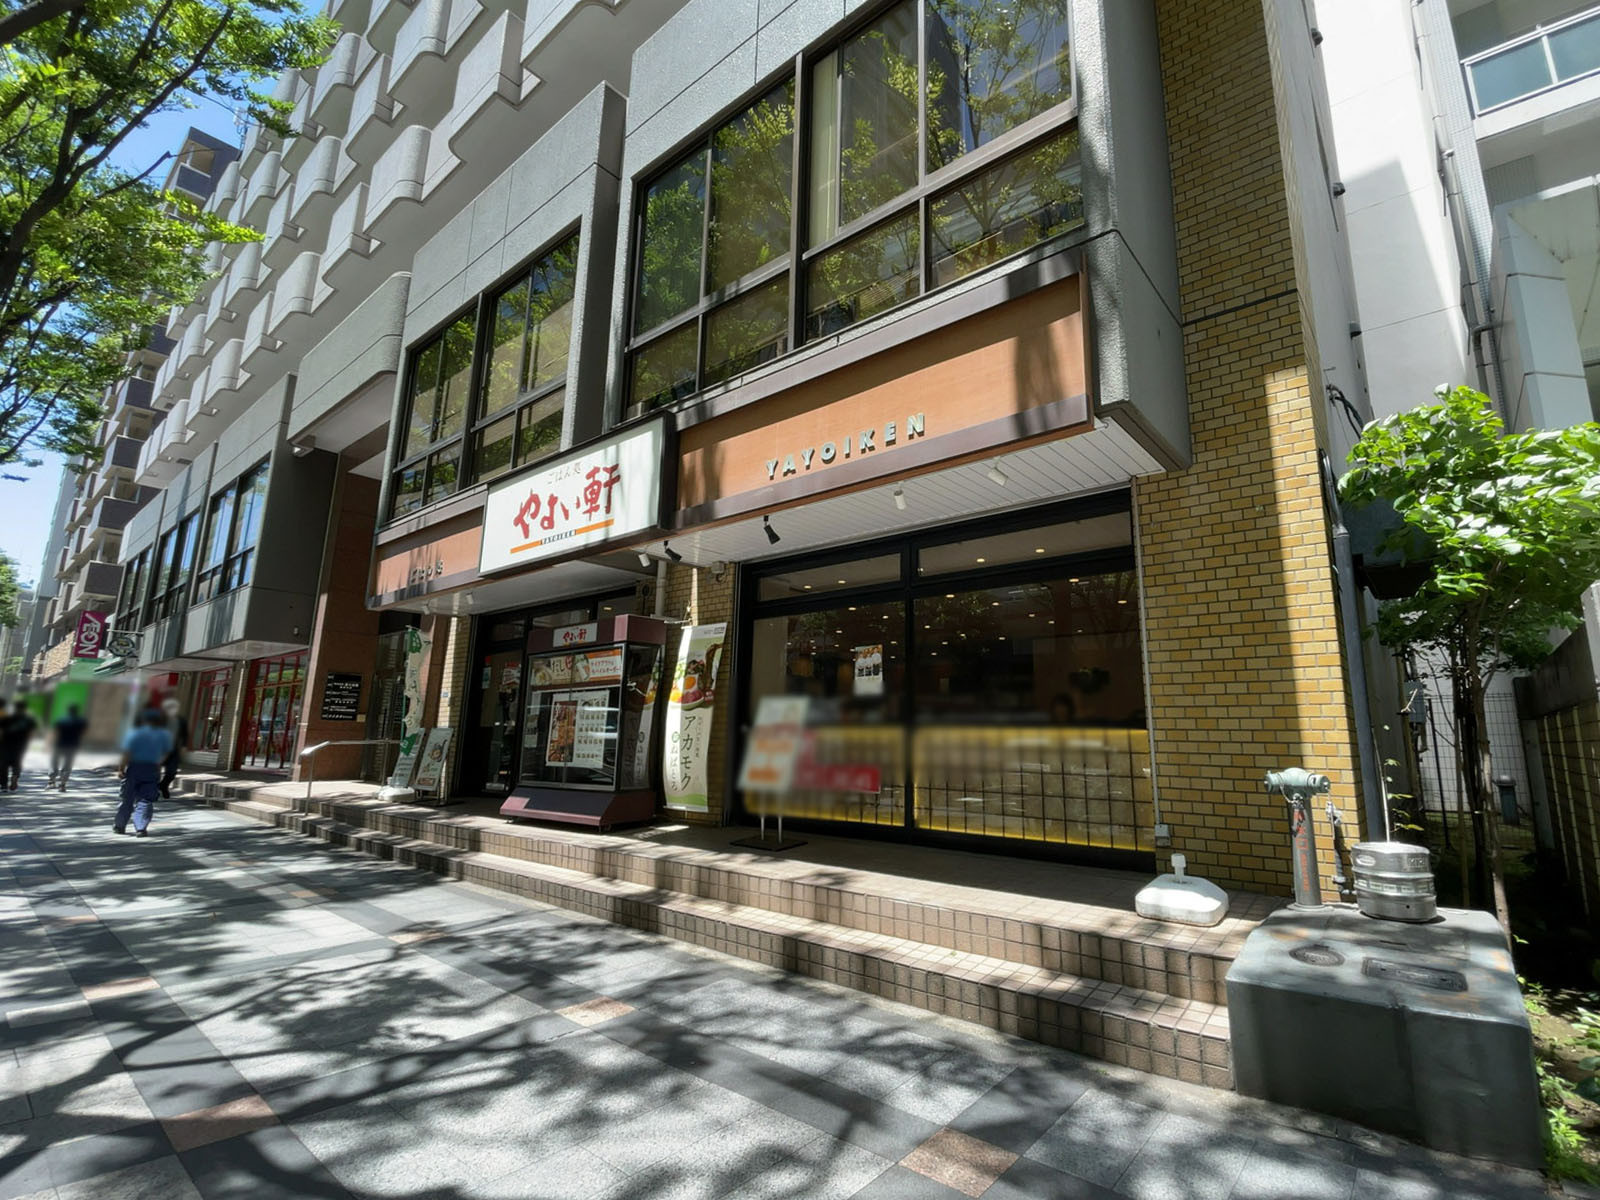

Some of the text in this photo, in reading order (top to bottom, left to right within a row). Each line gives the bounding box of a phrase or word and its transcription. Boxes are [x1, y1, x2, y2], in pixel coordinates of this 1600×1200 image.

[766, 412, 925, 480] YAYOIKEN
[513, 463, 621, 539] やよい軒
[681, 716, 696, 791] アカモク
